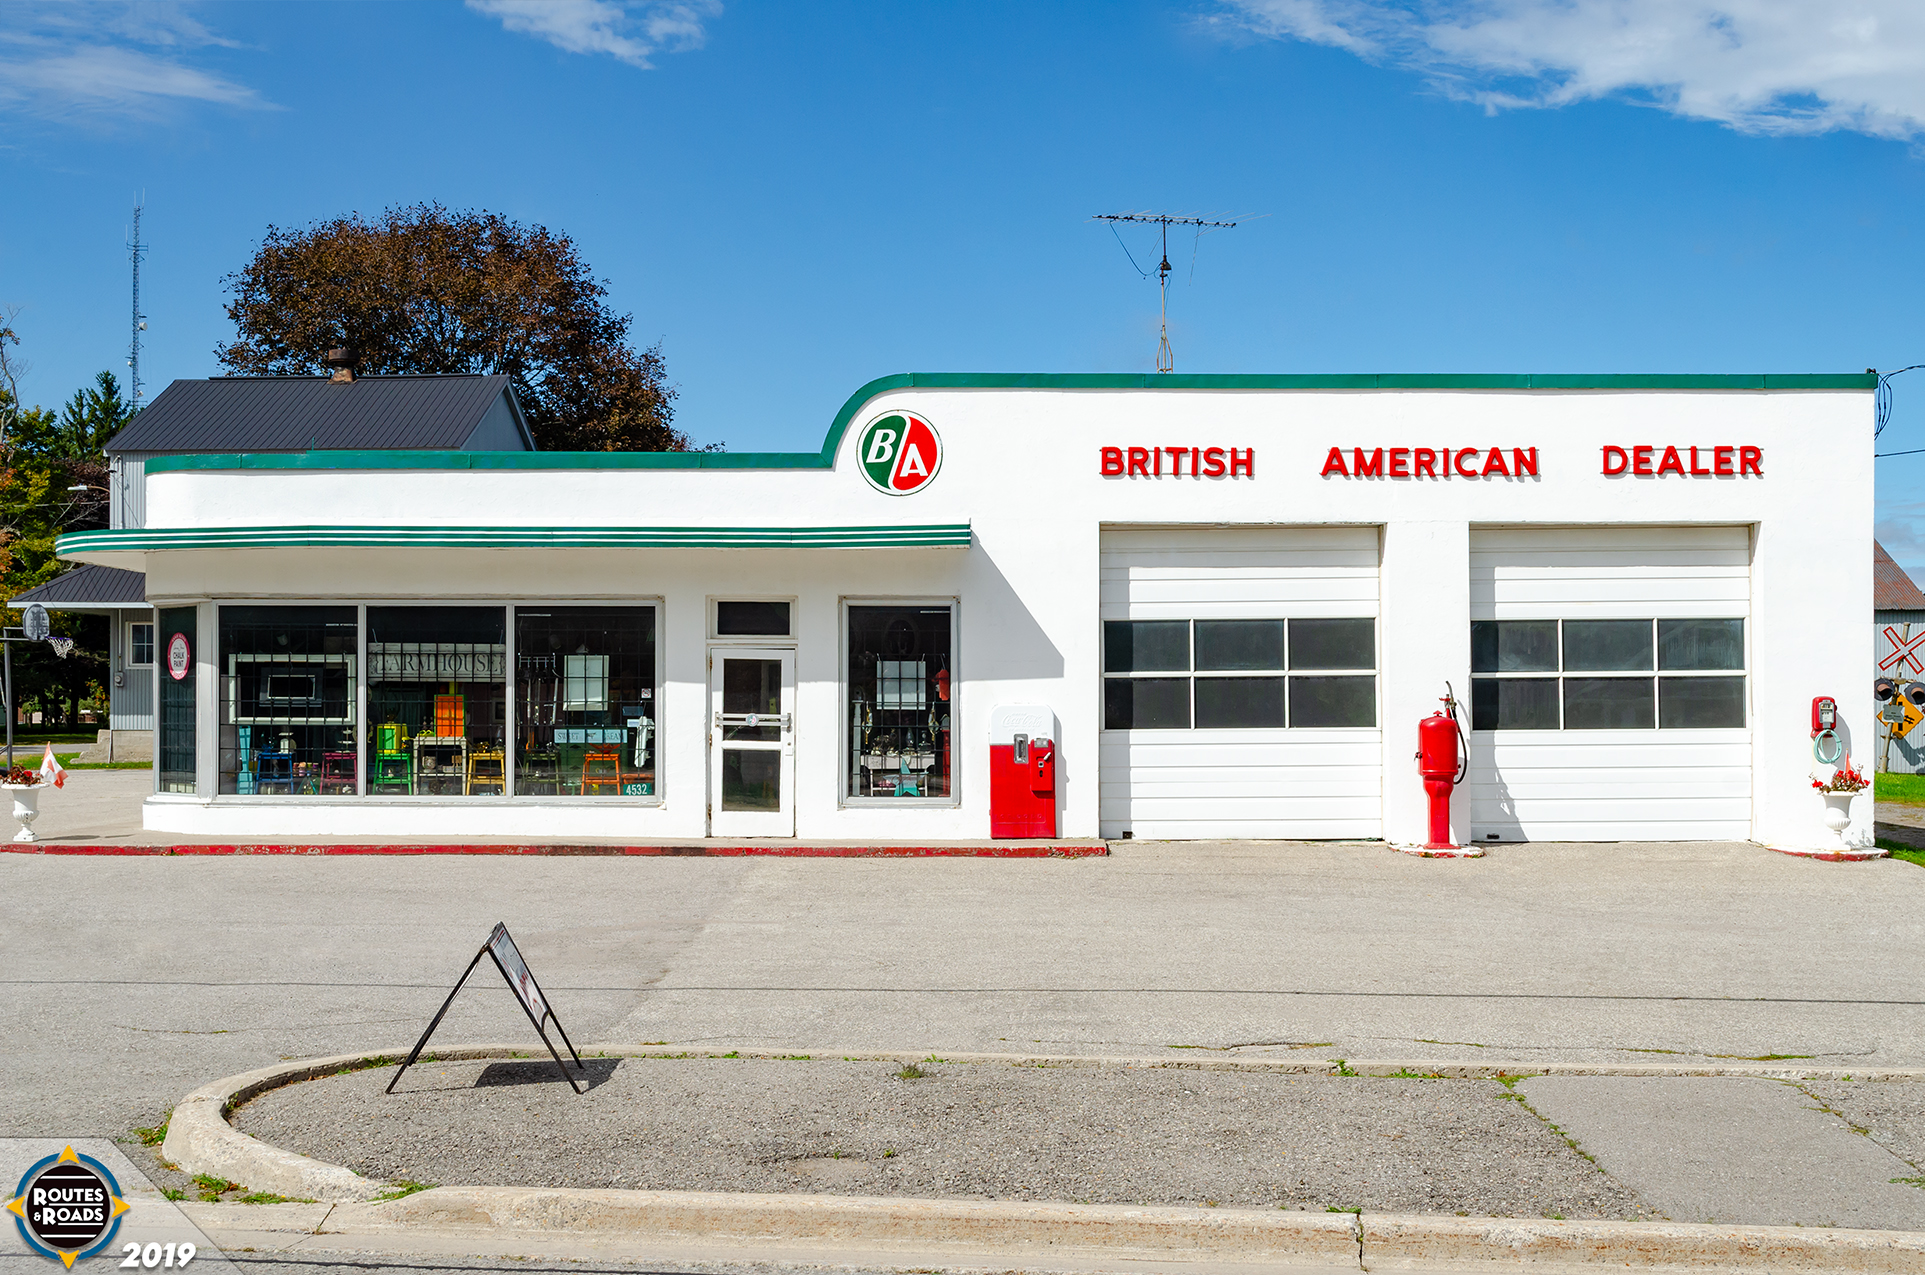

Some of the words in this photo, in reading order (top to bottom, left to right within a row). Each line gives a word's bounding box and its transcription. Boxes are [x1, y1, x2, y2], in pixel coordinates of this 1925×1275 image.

[866, 429, 896, 463] B
[899, 443, 928, 477] A
[1101, 446, 1253, 477] BRITISH
[1320, 446, 1538, 478] AMERICAN
[1603, 445, 1762, 476] DEALER
[381, 653, 498, 672] FARMHOUSE
[626, 783, 648, 796] 4532
